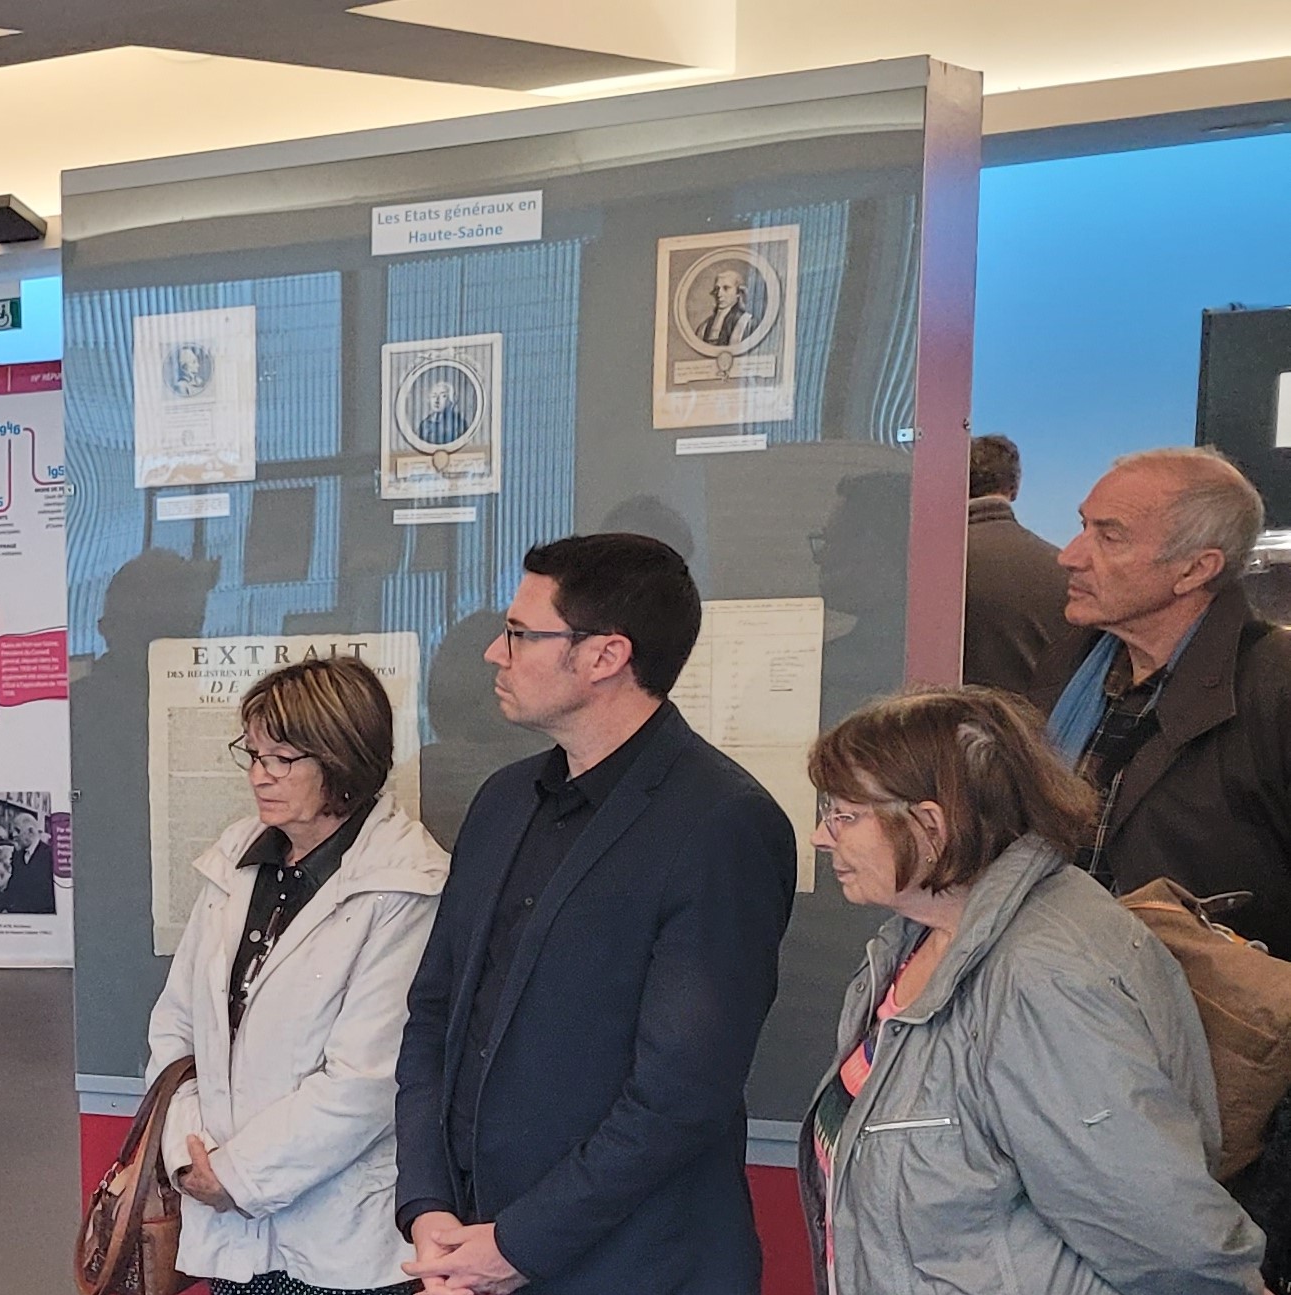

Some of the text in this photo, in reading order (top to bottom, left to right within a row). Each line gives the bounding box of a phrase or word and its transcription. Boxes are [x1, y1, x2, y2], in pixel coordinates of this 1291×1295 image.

[377, 199, 536, 225] Les Etats généraux en
[408, 224, 503, 244] Haute-Saône
[192, 642, 368, 666] EXTRAIT
[210, 680, 240, 694] DE
